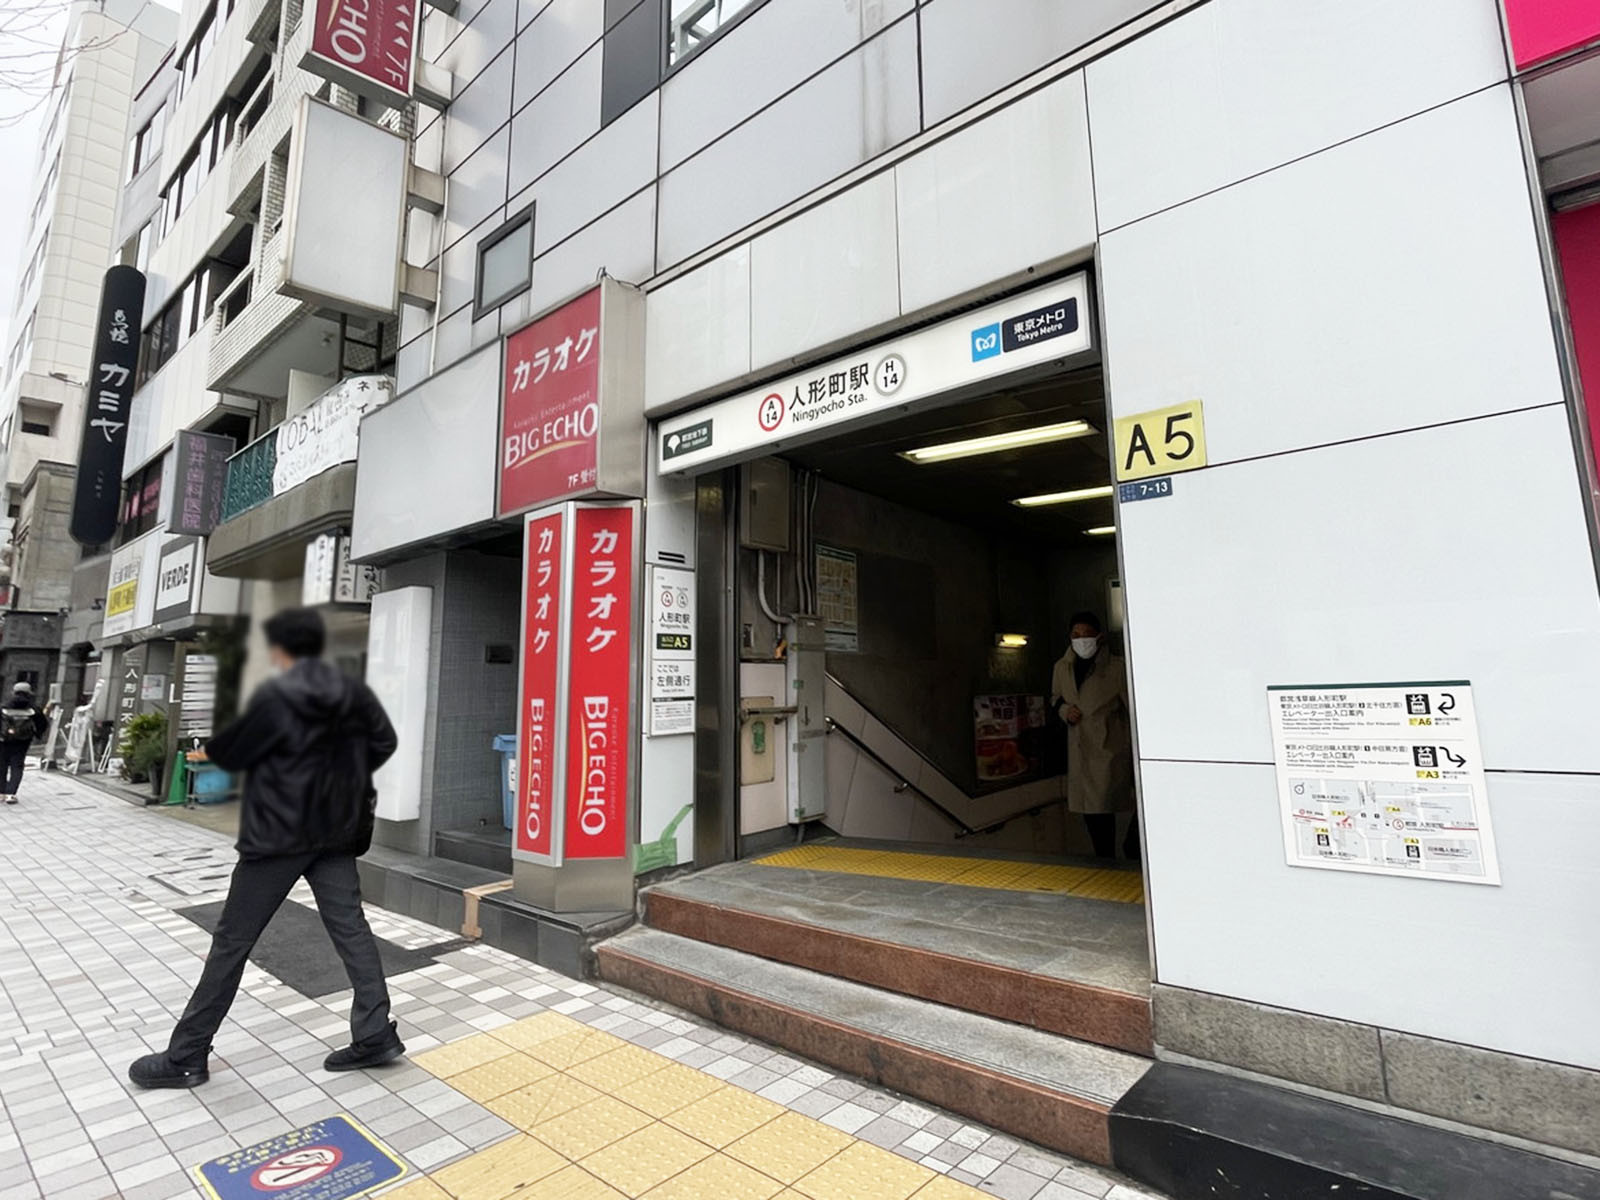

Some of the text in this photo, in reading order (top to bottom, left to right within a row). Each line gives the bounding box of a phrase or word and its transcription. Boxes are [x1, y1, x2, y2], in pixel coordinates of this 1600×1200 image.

[384, 51, 408, 85] 7F
[1013, 308, 1065, 335] 東京メトロ
[1017, 322, 1063, 342] Tokyo Metro
[512, 327, 597, 393] カラオケ
[885, 361, 894, 373] H
[789, 363, 869, 410] 人形町駅
[883, 373, 898, 388] 14
[90, 363, 131, 443] カミヤ
[766, 411, 777, 423] 14
[768, 400, 775, 411] A
[792, 392, 868, 423] Ningyocho Sta.
[504, 402, 599, 469] BIG ECHO
[568, 473, 579, 489] 7F
[1140, 481, 1168, 495] 7-13
[161, 563, 190, 592] VERDE
[534, 528, 553, 654] カラオケ
[586, 529, 618, 652] カラオケ
[674, 637, 688, 649] A5
[1418, 718, 1432, 726] A6
[526, 699, 544, 840] BIG ECHO
[581, 696, 609, 836] BIG ECHO
[1425, 770, 1439, 778] A3
